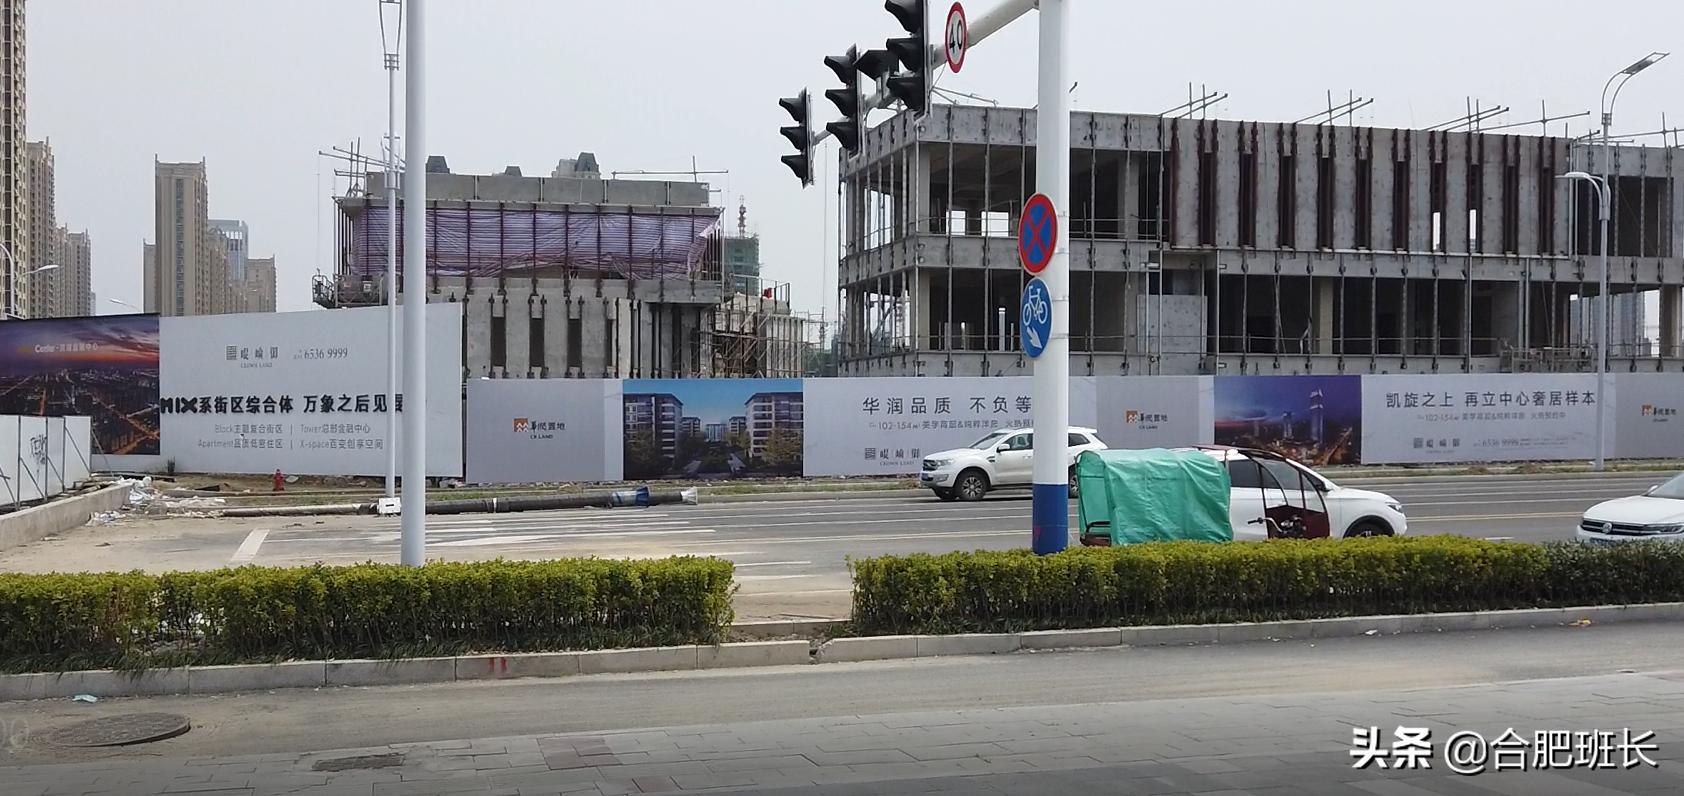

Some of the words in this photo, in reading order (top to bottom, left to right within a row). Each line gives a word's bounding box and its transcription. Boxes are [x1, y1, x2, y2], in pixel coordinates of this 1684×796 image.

[949, 20, 962, 53] 40
[304, 348, 325, 360] 6536
[327, 347, 348, 359] 9999
[160, 395, 293, 414] MIX系街区综合体
[862, 397, 951, 415] 华润品质
[1386, 391, 1453, 409] 凯旋之上
[1465, 390, 1596, 408] 再立中心奢居样本
